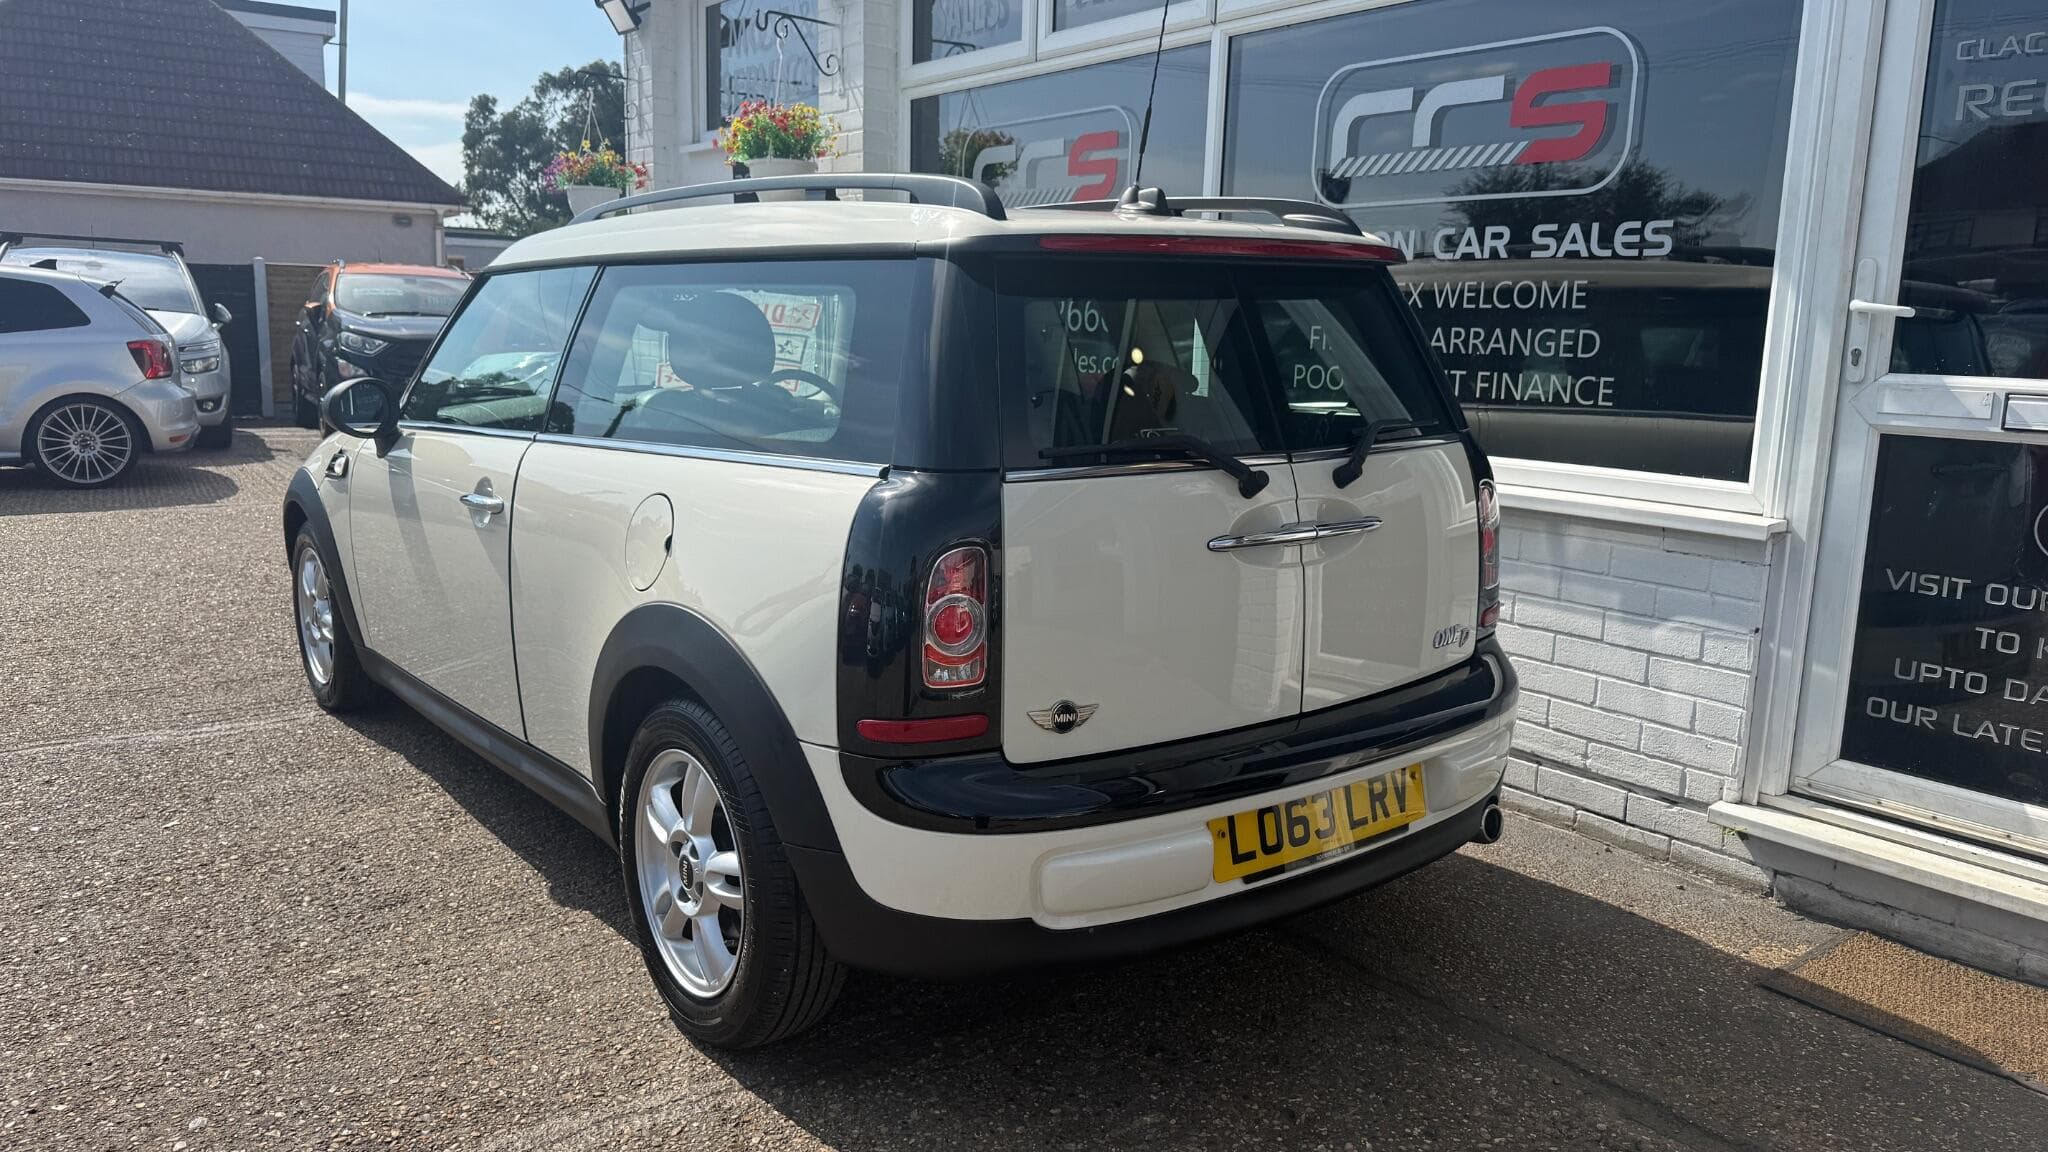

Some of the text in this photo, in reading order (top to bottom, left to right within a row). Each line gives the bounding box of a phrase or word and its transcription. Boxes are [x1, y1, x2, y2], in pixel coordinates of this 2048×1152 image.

[1955, 79, 2048, 121] RE
[1433, 225, 1511, 260] CAR
[1530, 219, 1675, 259] SALES
[1433, 279, 1589, 310] WELCOME
[1430, 326, 1601, 359] ARRANGED
[1475, 370, 1615, 407] FINANCE
[1886, 567, 1972, 600] VISIT
[1975, 626, 2021, 655] TO
[1893, 657, 1988, 695] UPTO
[1054, 712, 1077, 723] MINI
[1866, 696, 2048, 753] OUR LATE
[1227, 767, 1408, 866] LO63 LRV
